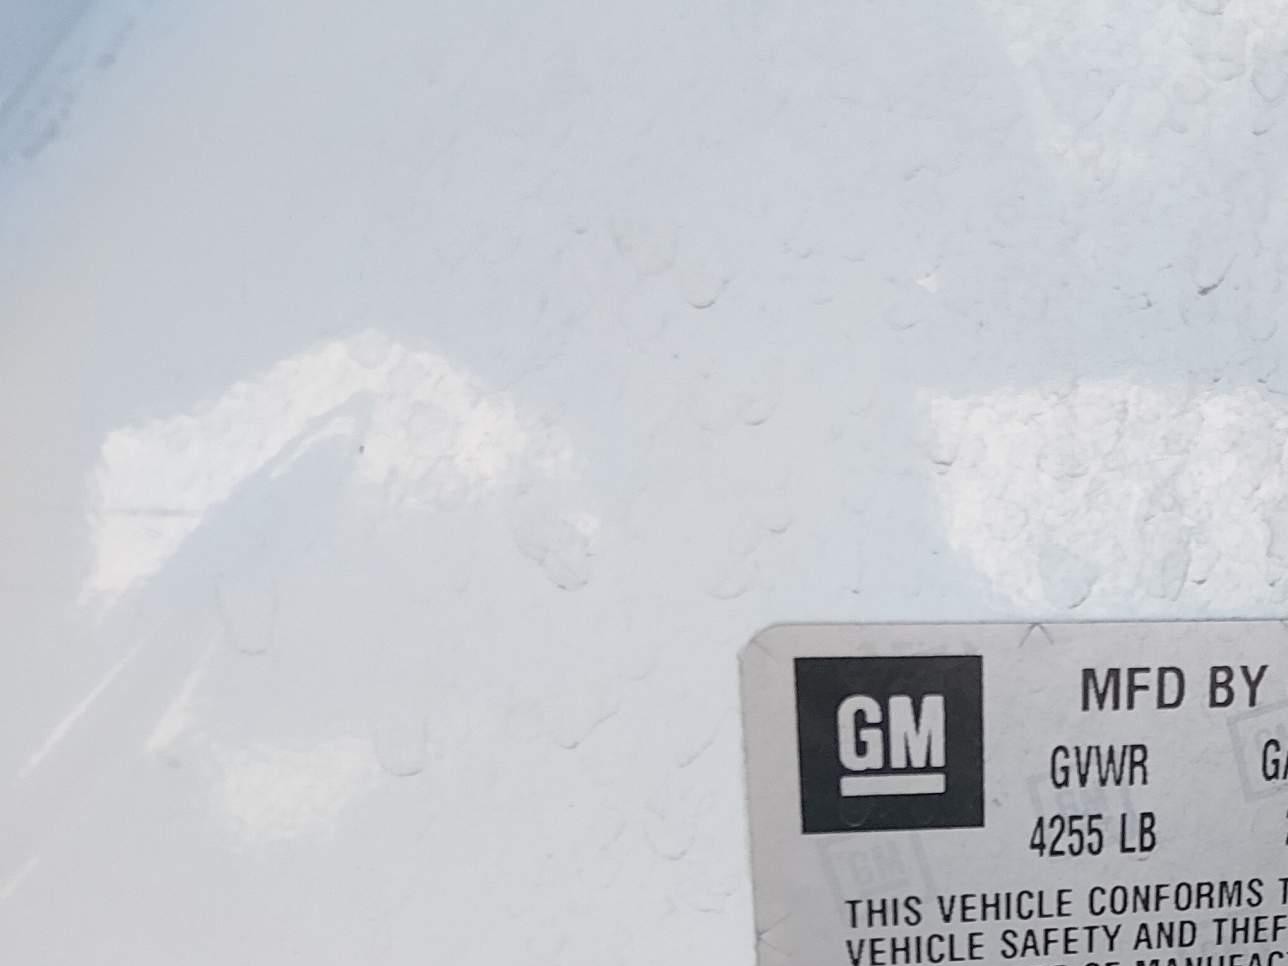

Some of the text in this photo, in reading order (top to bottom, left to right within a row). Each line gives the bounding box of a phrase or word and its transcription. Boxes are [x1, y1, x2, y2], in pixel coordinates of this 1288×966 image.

[1082, 667, 1184, 711] MFD
[1210, 665, 1268, 708] BY
[837, 694, 946, 772] GM
[1051, 744, 1147, 789] GVWR
[1030, 812, 1156, 856] 4255 LB
[846, 896, 921, 928] THIS
[938, 889, 1072, 923] VEHICLE
[1089, 879, 1263, 916] CONFORMS
[847, 933, 983, 966] VEHICLE
[1001, 925, 1121, 958] SAFETY
[1134, 921, 1196, 950] AND
